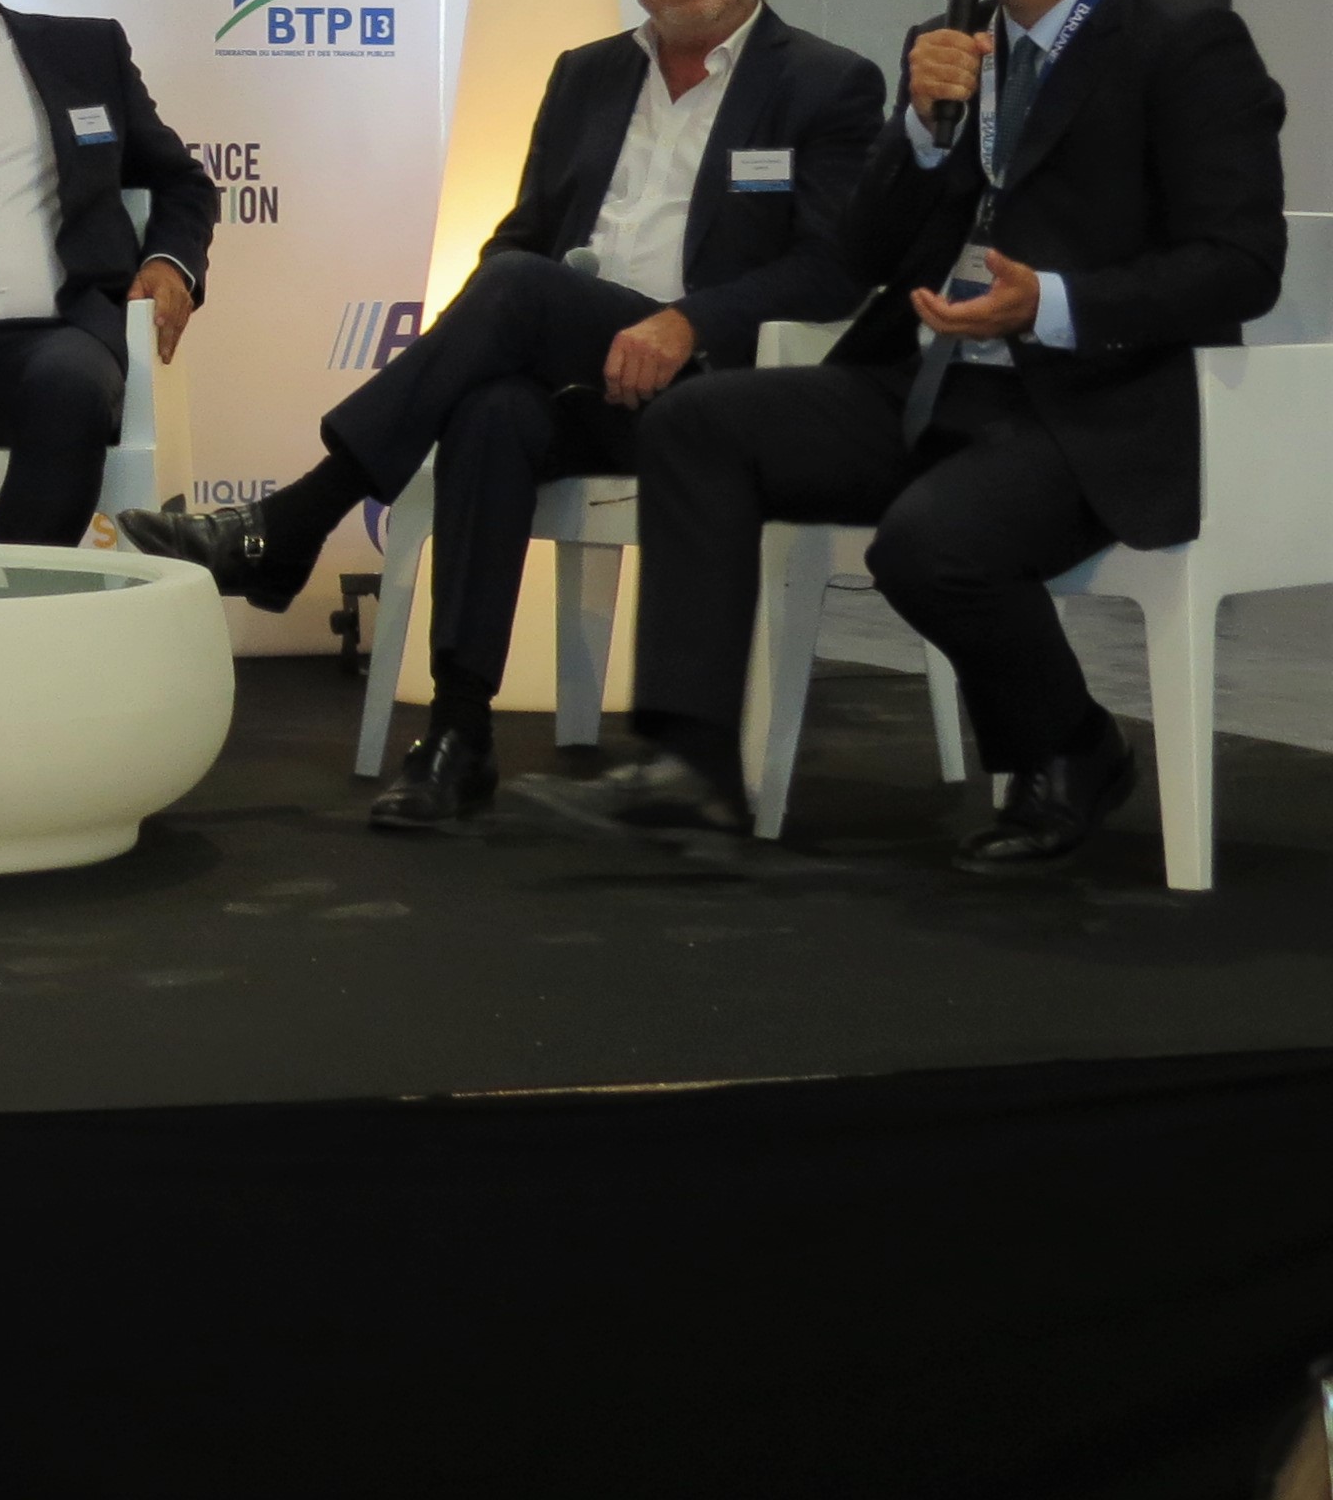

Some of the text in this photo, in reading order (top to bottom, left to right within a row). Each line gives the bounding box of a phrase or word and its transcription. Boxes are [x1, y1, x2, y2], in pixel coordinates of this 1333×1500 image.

[268, 7, 390, 45] BTP 13
[1041, 2, 1090, 64] BARJANE
